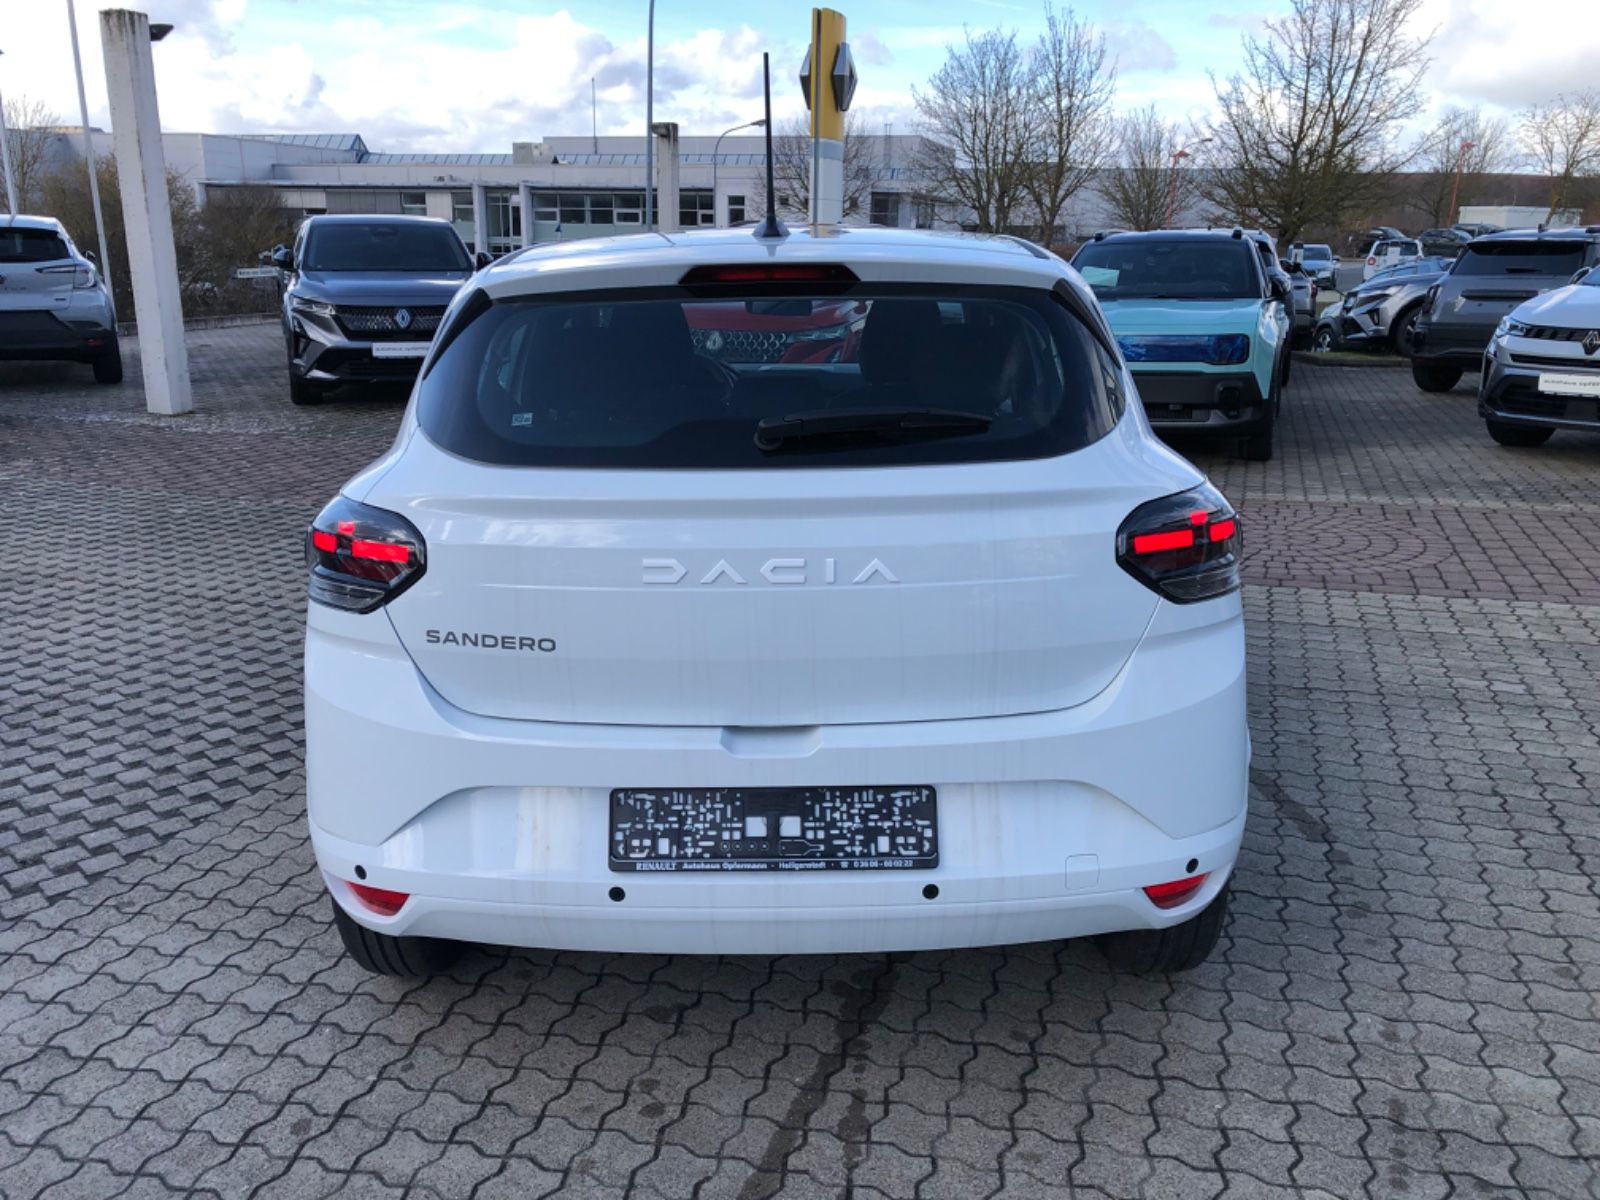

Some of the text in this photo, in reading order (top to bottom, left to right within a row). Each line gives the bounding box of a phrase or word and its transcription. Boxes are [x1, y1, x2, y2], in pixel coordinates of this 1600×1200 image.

[641, 557, 900, 584] DACIA
[426, 629, 557, 652] SANDERO
[635, 861, 677, 871] RENAULT
[682, 861, 721, 870] Autohaus
[722, 860, 768, 871] Opfermann
